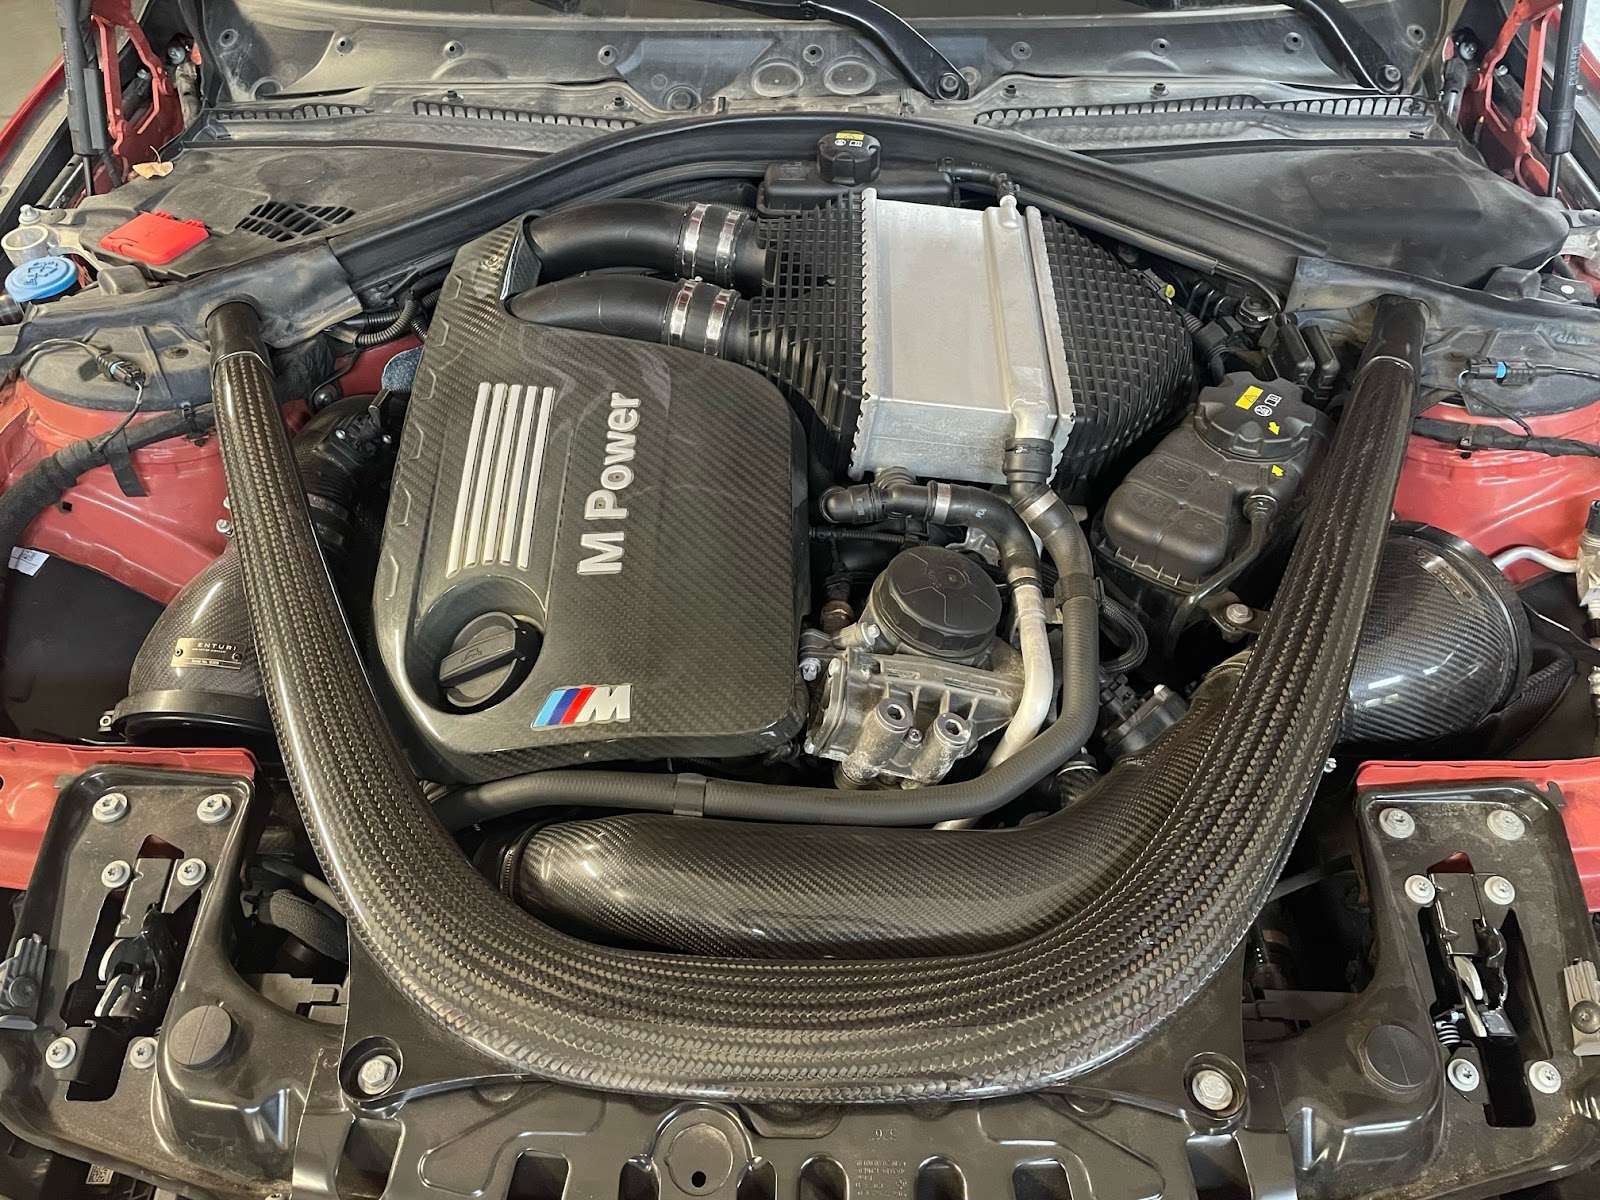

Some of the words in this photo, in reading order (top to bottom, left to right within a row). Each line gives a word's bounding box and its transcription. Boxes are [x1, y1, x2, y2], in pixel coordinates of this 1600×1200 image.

[584, 392, 642, 521] Power
[577, 532, 625, 576] M
[196, 642, 237, 652] ENTURI
[574, 683, 632, 723] M
